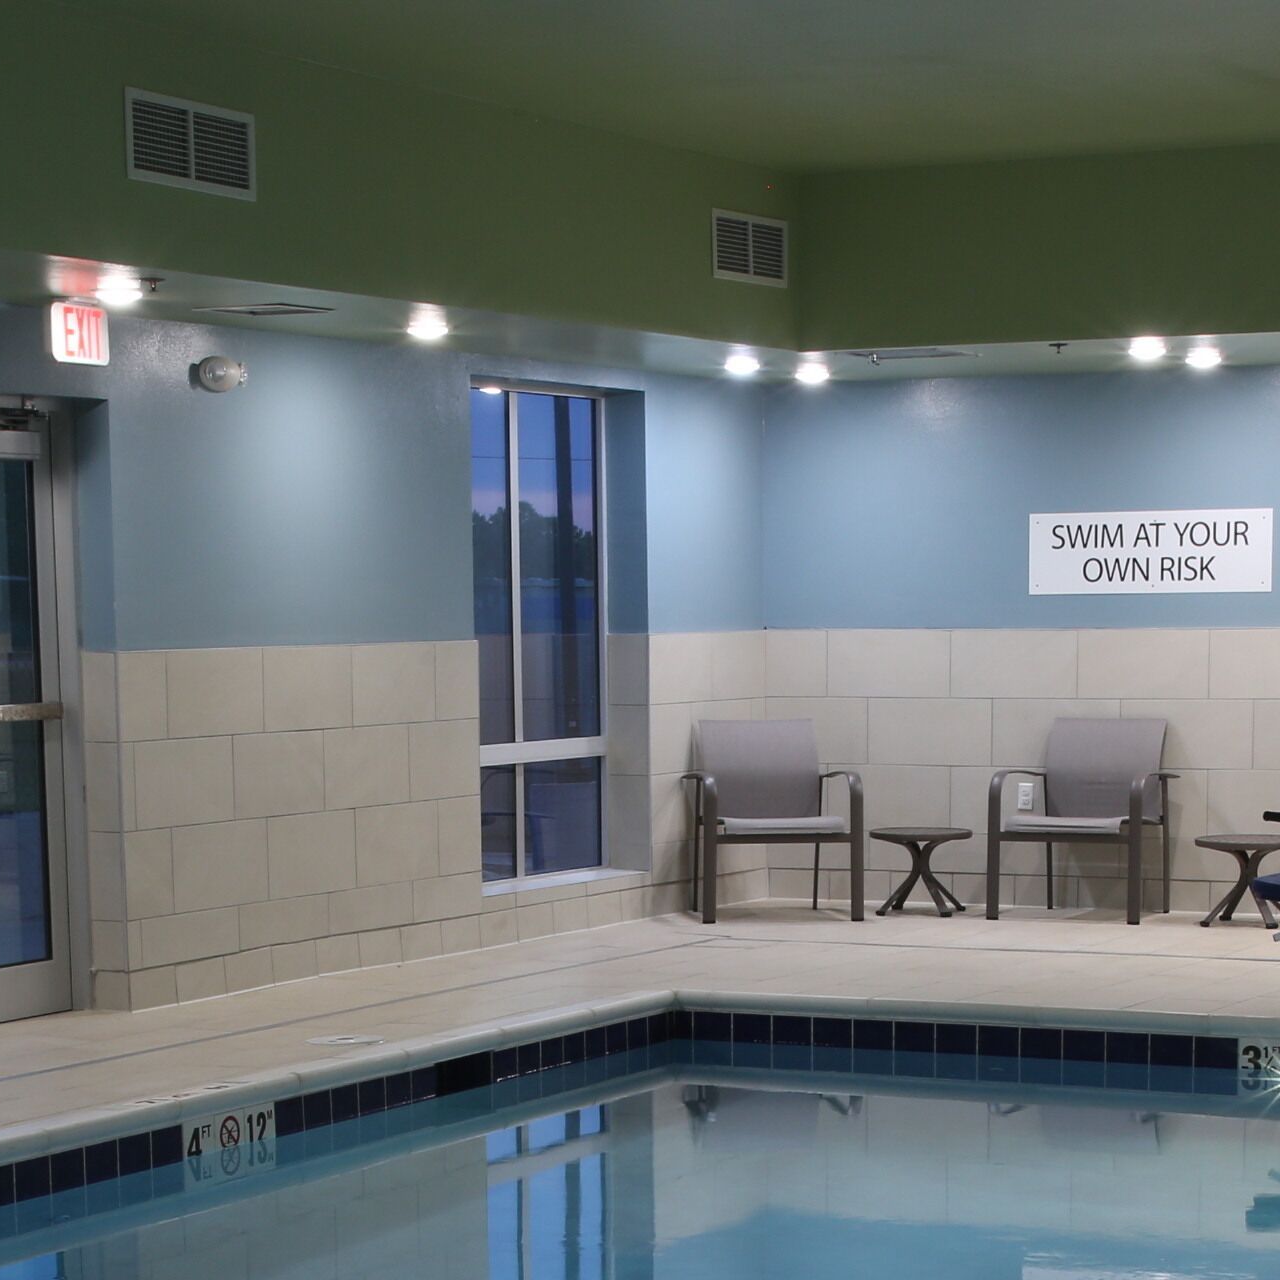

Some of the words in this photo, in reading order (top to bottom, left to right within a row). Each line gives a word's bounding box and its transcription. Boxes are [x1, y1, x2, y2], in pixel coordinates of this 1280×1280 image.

[64, 306, 103, 360] EXIT
[1051, 523, 1124, 550] SWIM
[1133, 522, 1166, 548] AT
[1174, 520, 1249, 547] YOUR
[1083, 557, 1150, 583] OWN
[1160, 555, 1216, 582] RISK
[187, 1127, 202, 1157] 4
[202, 1124, 211, 1139] FT
